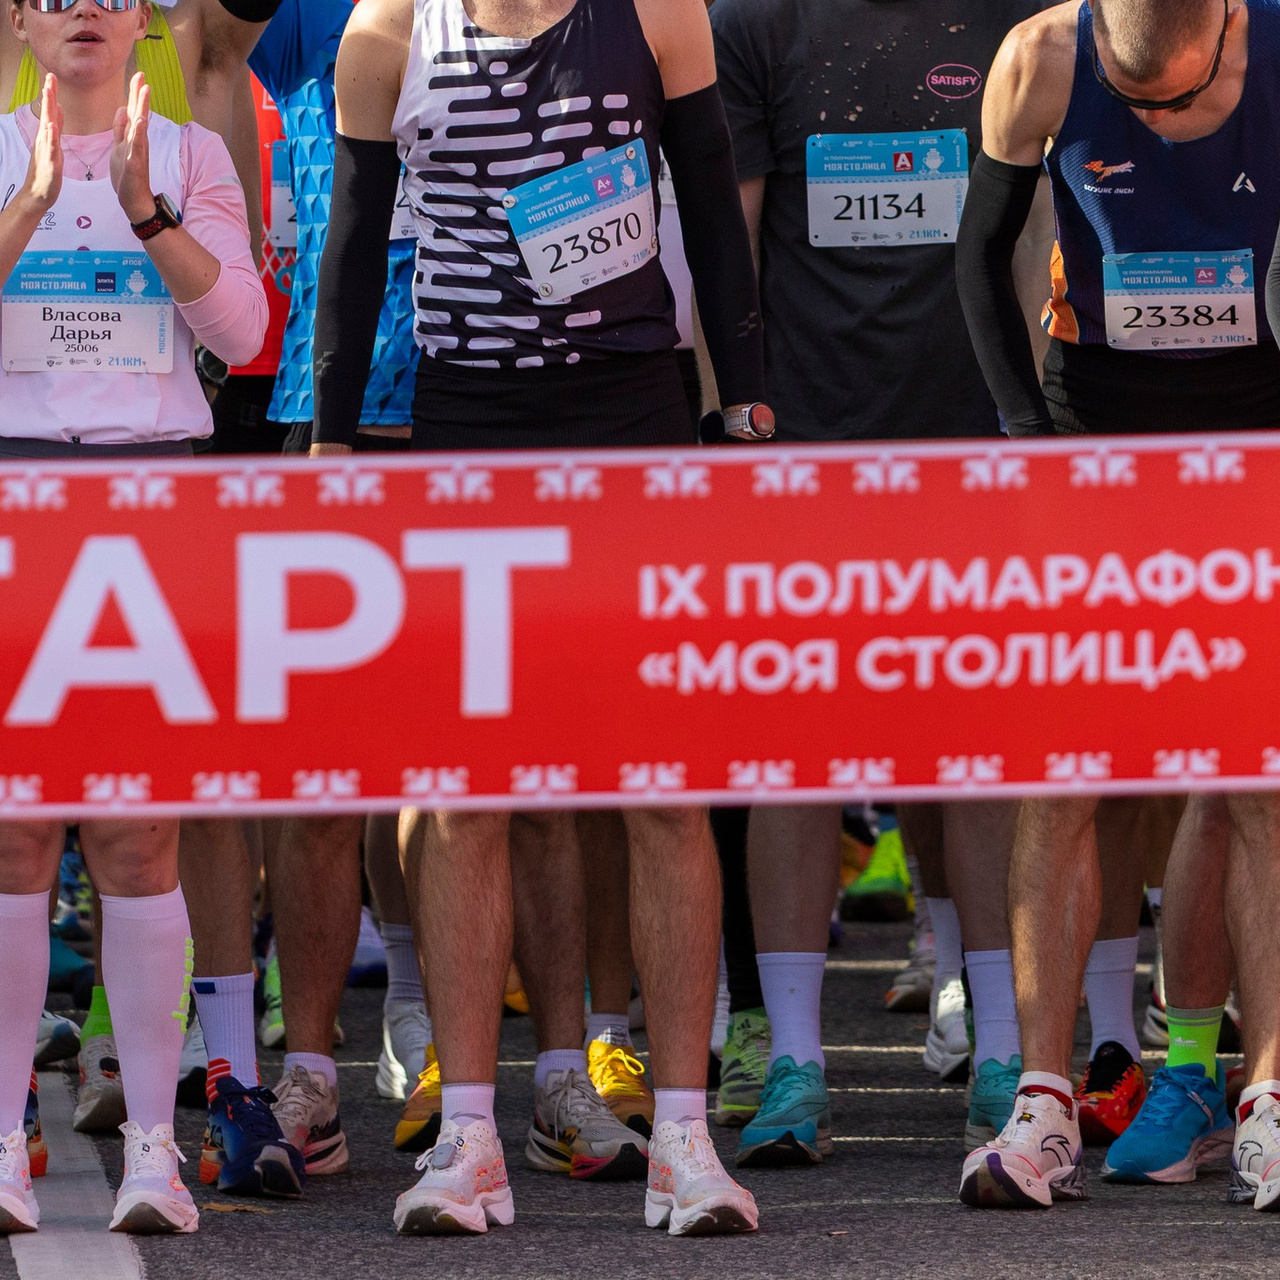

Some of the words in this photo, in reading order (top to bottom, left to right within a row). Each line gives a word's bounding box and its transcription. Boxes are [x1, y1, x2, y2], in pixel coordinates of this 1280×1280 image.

[930, 74, 977, 87] SATISFY
[823, 163, 843, 171] МОЯ
[844, 162, 887, 171] СТОЛИЦА
[527, 210, 548, 225] МОЯ
[548, 193, 590, 218] СТОЛИЦА
[833, 192, 926, 221] 21134
[541, 212, 642, 274] 23870
[21, 281, 41, 290] МОЯ
[42, 281, 87, 291] СТОЛИЦА
[1123, 277, 1142, 285] МОЯ
[1143, 276, 1188, 285] СТОЛИЦА
[42, 307, 122, 323] Власова
[1123, 304, 1239, 329] 23384
[50, 325, 112, 344] Дарья
[1212, 335, 1246, 344] 21.1КМ
[64, 344, 99, 353] 25006
[108, 356, 142, 367] 21.1КМ
[638, 563, 708, 619] IX
[638, 639, 838, 695] «МОЯ
[856, 627, 1247, 692] СТОЛИЦА»
